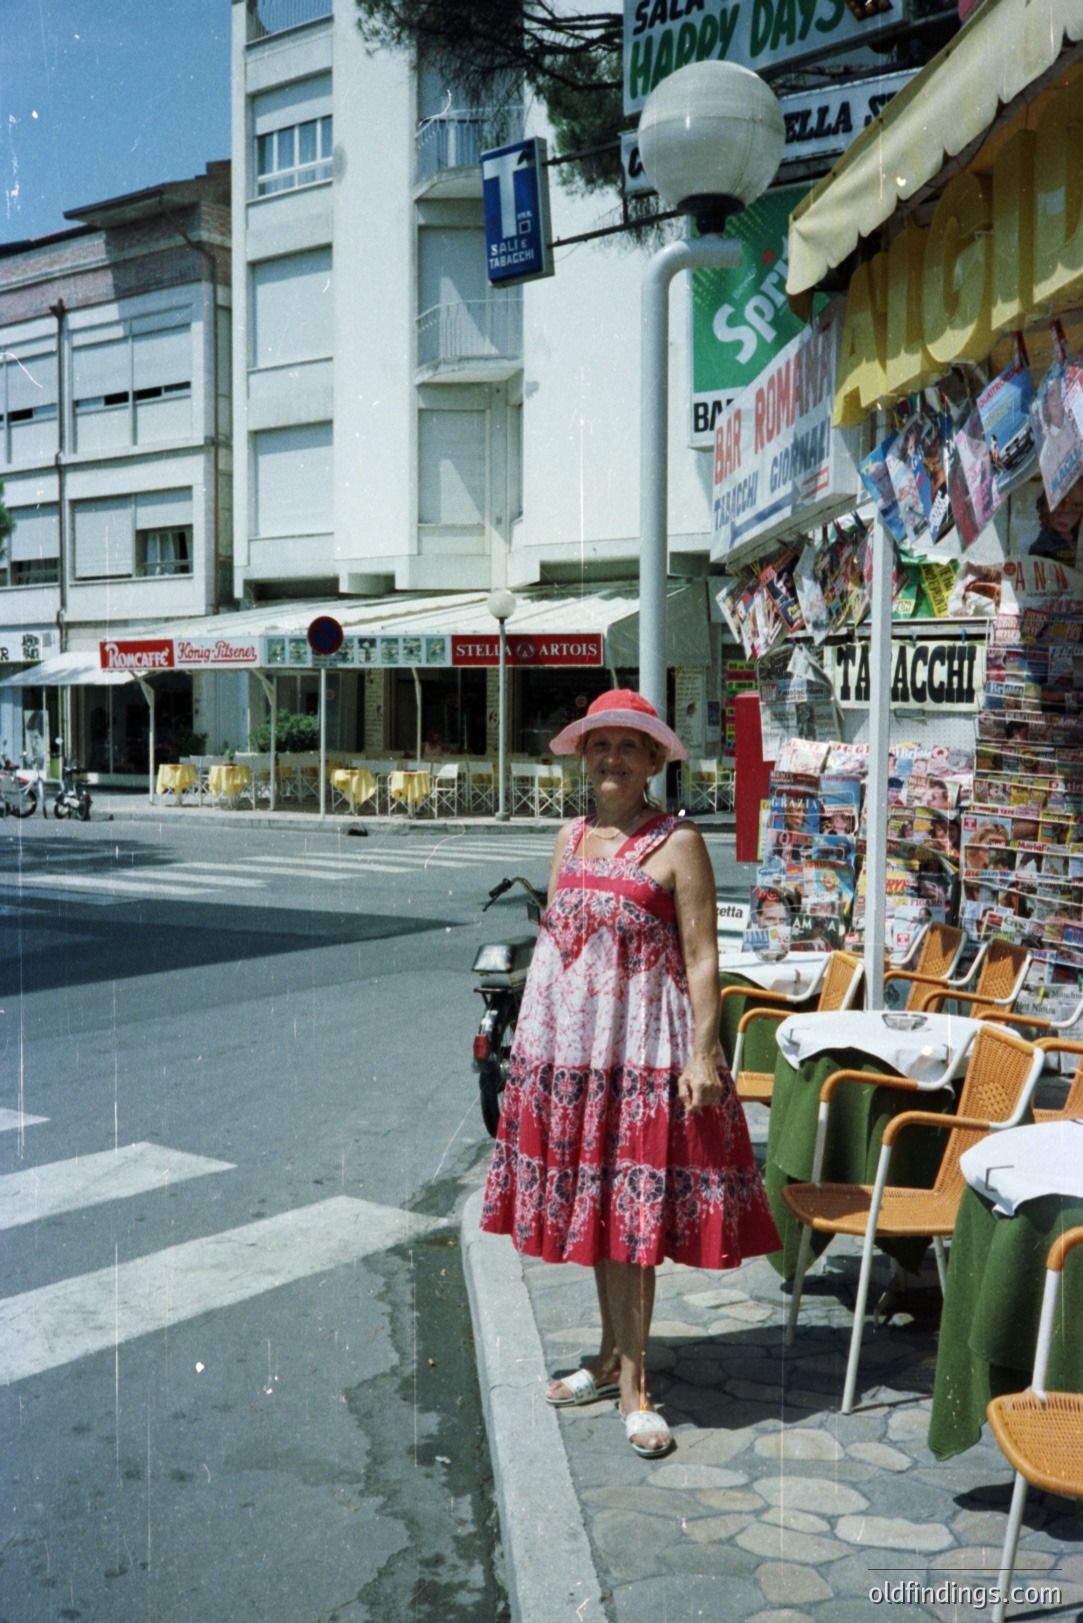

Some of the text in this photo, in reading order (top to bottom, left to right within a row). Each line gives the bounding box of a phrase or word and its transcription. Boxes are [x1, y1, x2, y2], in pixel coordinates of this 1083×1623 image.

[630, 4, 740, 99] HAPPY
[483, 150, 529, 239] T
[489, 249, 534, 270] TABACCHI
[490, 239, 519, 256] SALI
[693, 398, 738, 433] BA
[714, 326, 832, 486] BAR ROMANA
[714, 415, 832, 531] TABACCHI GIORNALI
[456, 643, 598, 657] STELLA ARTOIS
[836, 644, 977, 704] TAACCHI
[771, 793, 819, 810] GRAZIA
